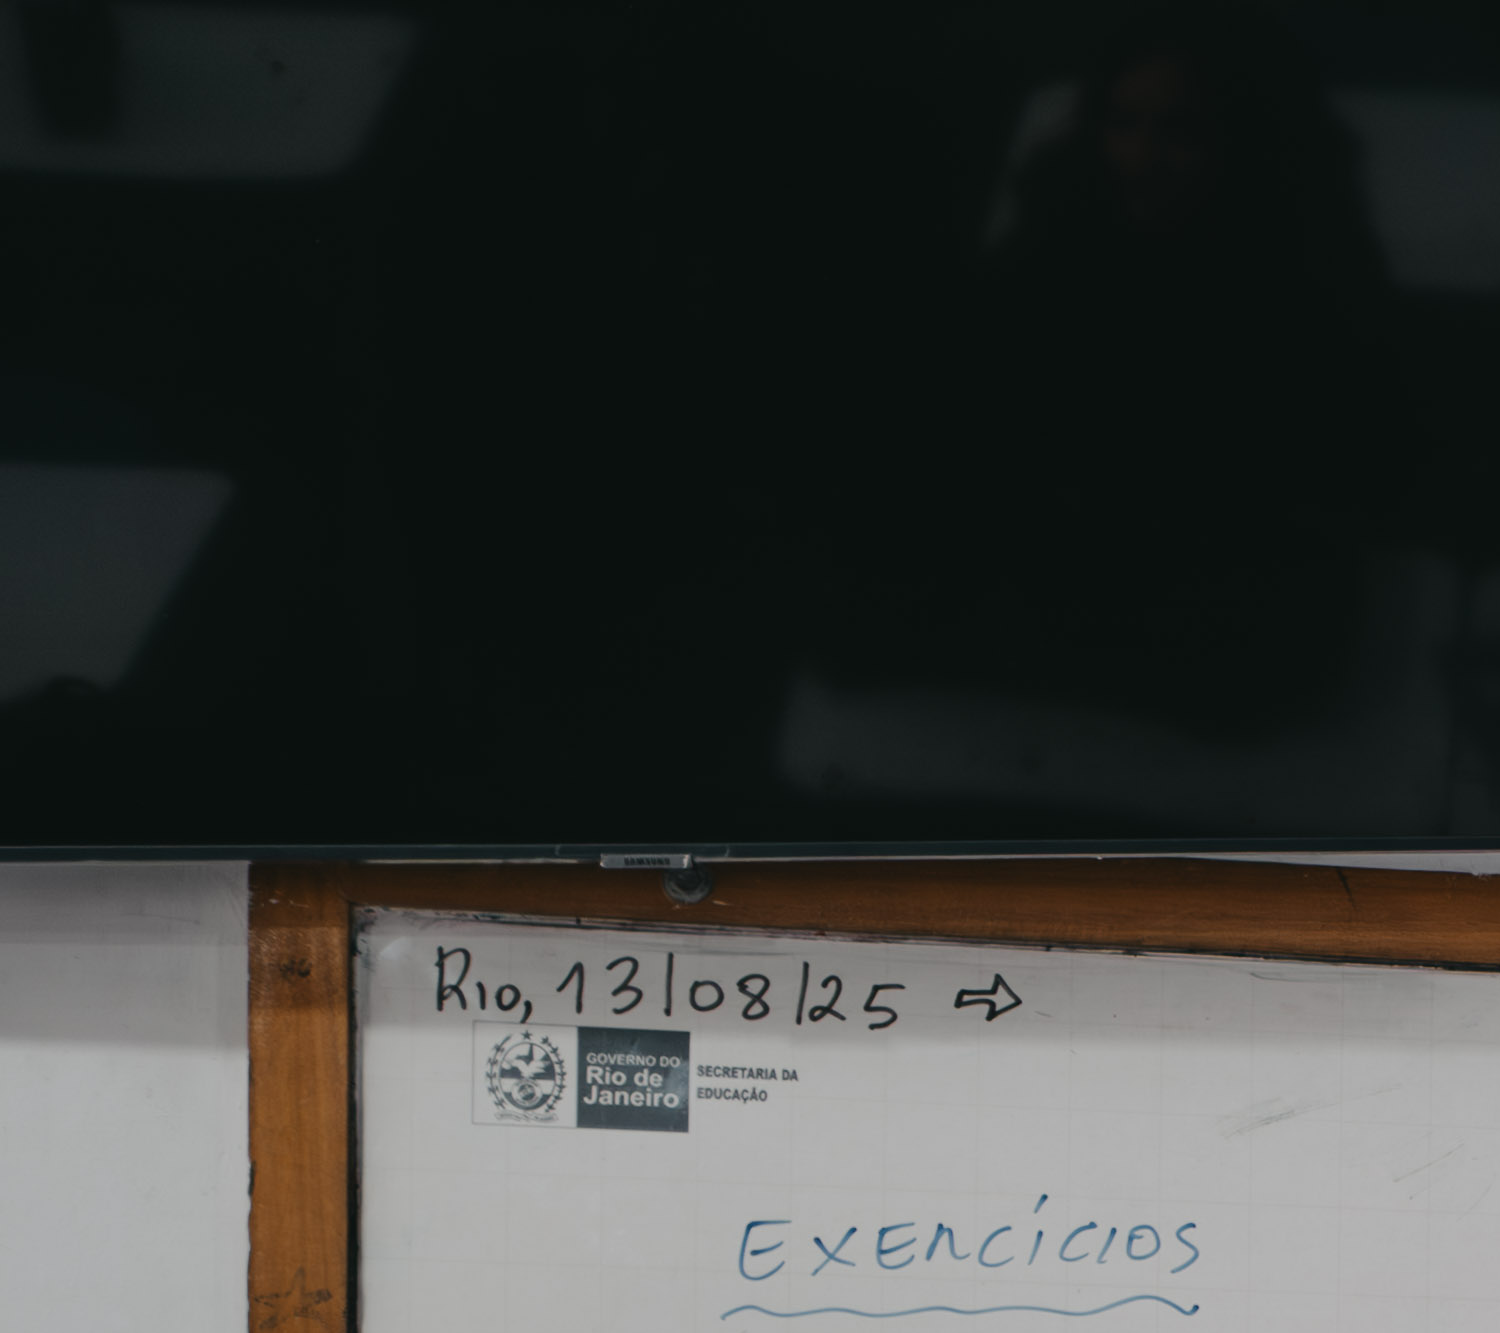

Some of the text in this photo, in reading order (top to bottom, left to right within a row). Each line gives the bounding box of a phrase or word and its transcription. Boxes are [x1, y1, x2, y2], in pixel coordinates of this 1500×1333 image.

[435, 947, 907, 1031] Rio, 13/08/25
[586, 1052, 681, 1068] GOVERNO DO
[585, 1066, 663, 1088] Rio de
[696, 1064, 799, 1081] SECRETARIA DA
[583, 1086, 680, 1110] Janeiro
[696, 1086, 769, 1104] EDUCAÇÃO
